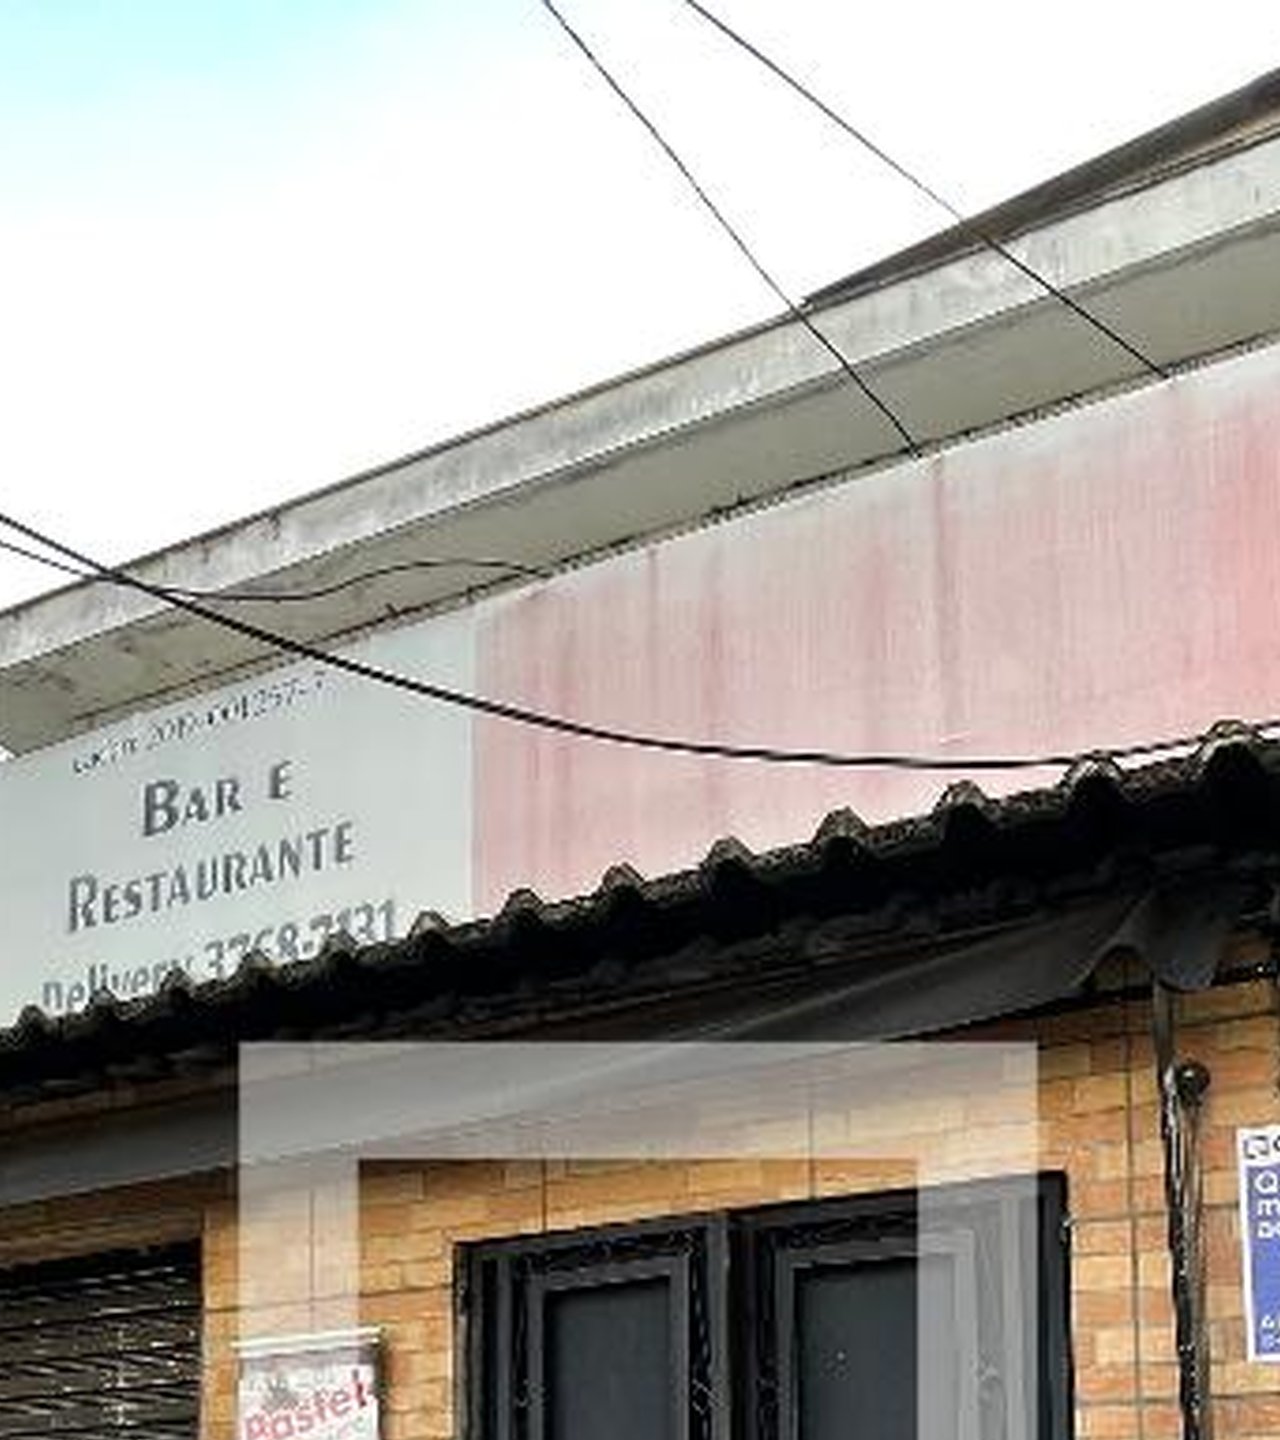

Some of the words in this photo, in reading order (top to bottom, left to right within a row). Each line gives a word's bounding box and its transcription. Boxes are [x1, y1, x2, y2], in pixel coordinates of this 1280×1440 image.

[143, 778, 243, 837] BAR
[269, 760, 293, 800] E
[68, 821, 354, 932] RESTAURANTE
[42, 956, 195, 1010] Deliver
